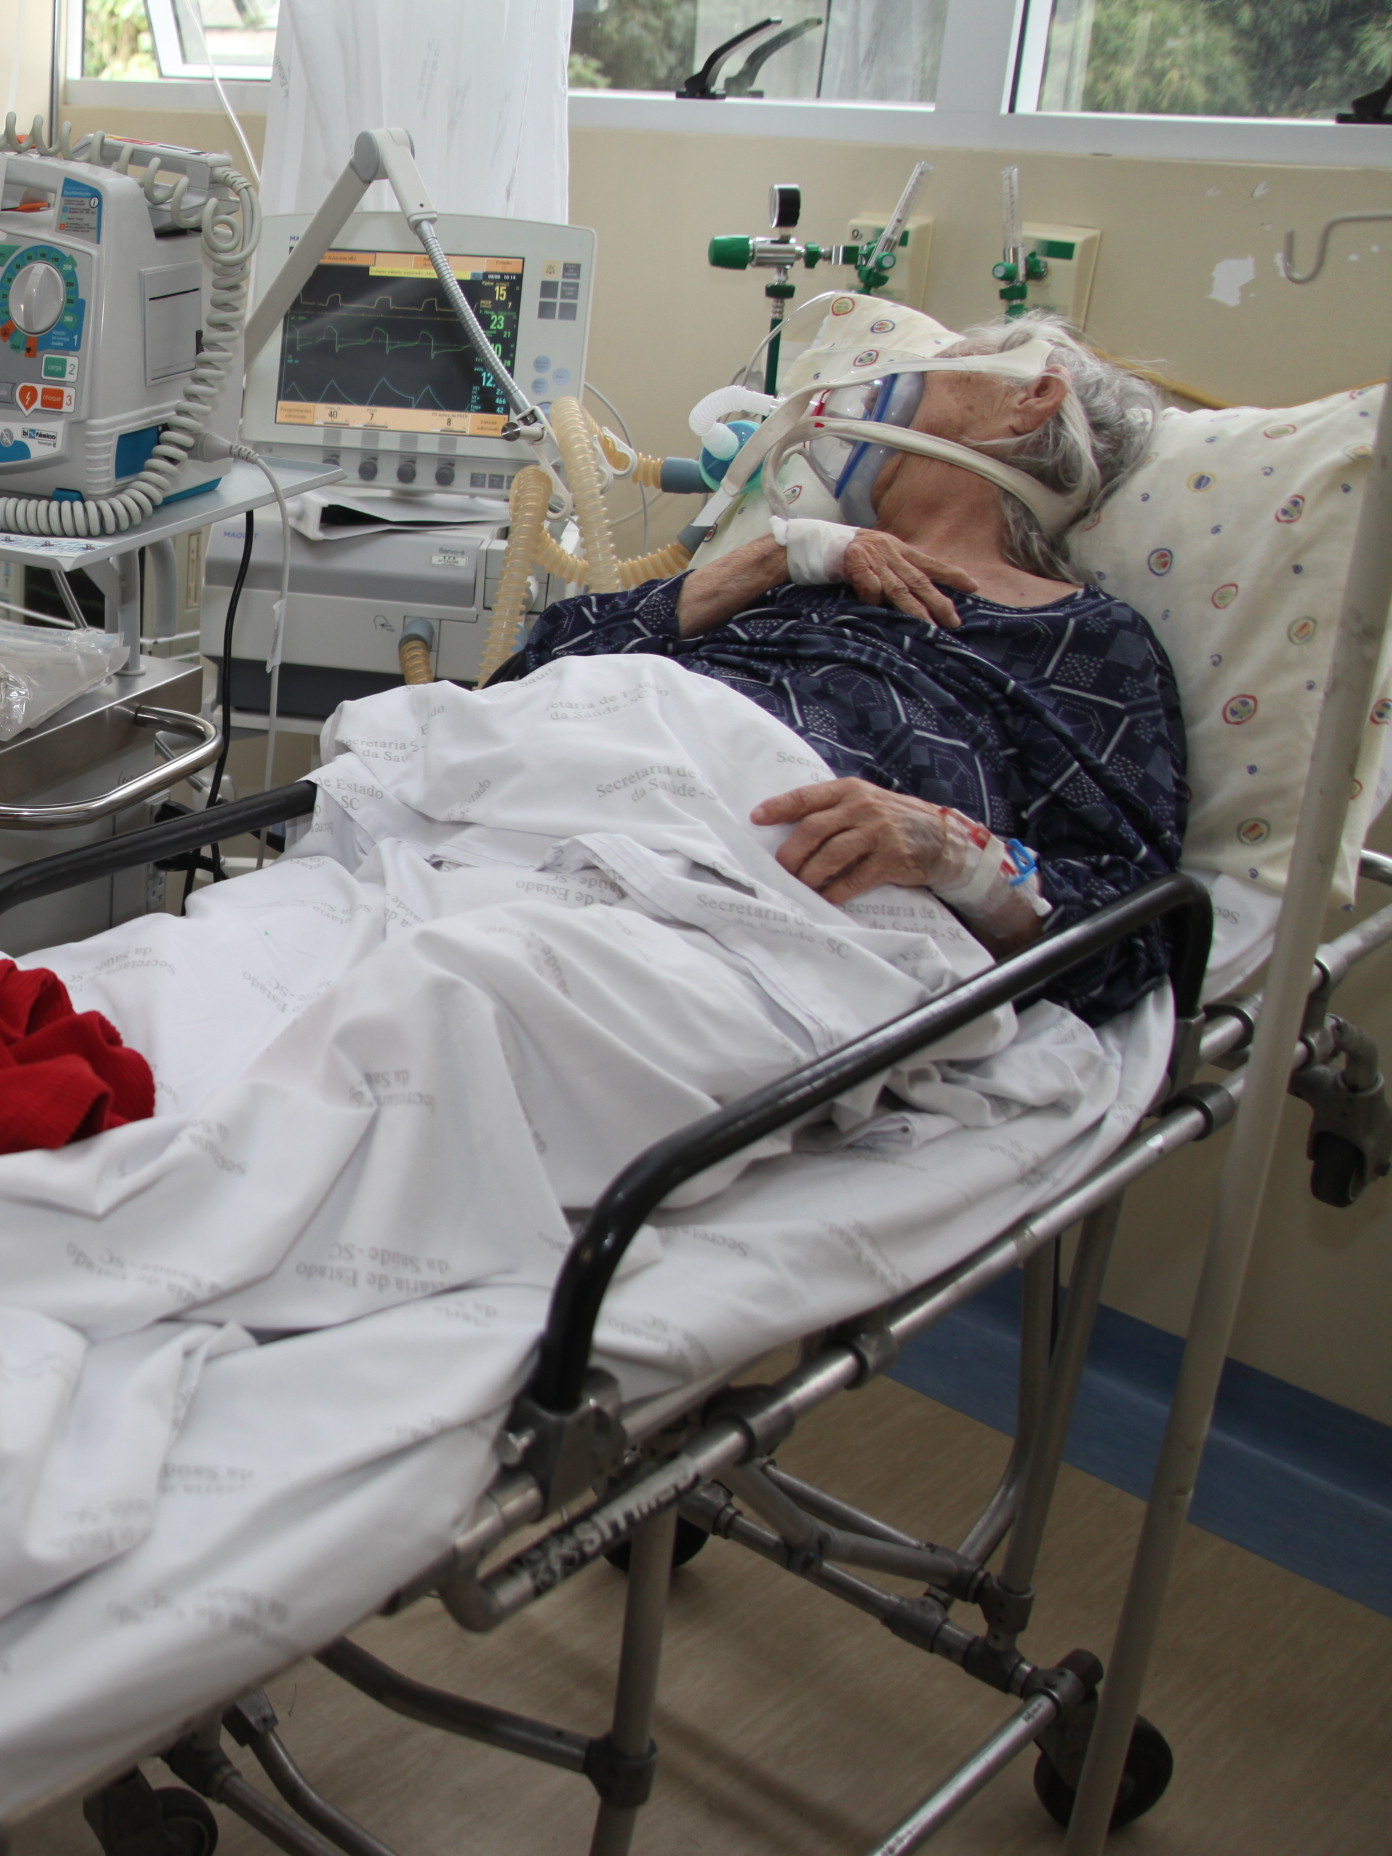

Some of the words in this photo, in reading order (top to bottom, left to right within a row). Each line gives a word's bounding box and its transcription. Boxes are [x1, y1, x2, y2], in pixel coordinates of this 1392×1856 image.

[494, 285, 507, 301] 15
[490, 315, 505, 330] 23
[68, 363, 76, 376] 2
[65, 394, 73, 407] 3
[328, 411, 338, 419] 40
[369, 413, 375, 421] 7
[446, 418, 452, 426] 8
[223, 531, 259, 540] MAQT
[362, 750, 379, 759] da
[336, 778, 384, 800] Estado
[596, 763, 672, 798] Secretaria
[676, 766, 696, 778] de
[631, 788, 647, 802] da
[648, 778, 697, 798] Saúde
[341, 795, 360, 811] SC
[514, 880, 570, 902] Estado
[696, 893, 789, 925] Secretaria
[919, 902, 936, 919] de
[946, 926, 968, 942] SC
[826, 938, 852, 960] SC
[241, 970, 289, 1014] Estado
[268, 976, 290, 998] SC
[328, 1241, 356, 1261] SC
[367, 1246, 421, 1274] Saúde
[425, 1258, 450, 1275] da
[295, 1261, 359, 1289] Estado
[365, 1271, 390, 1292] de
